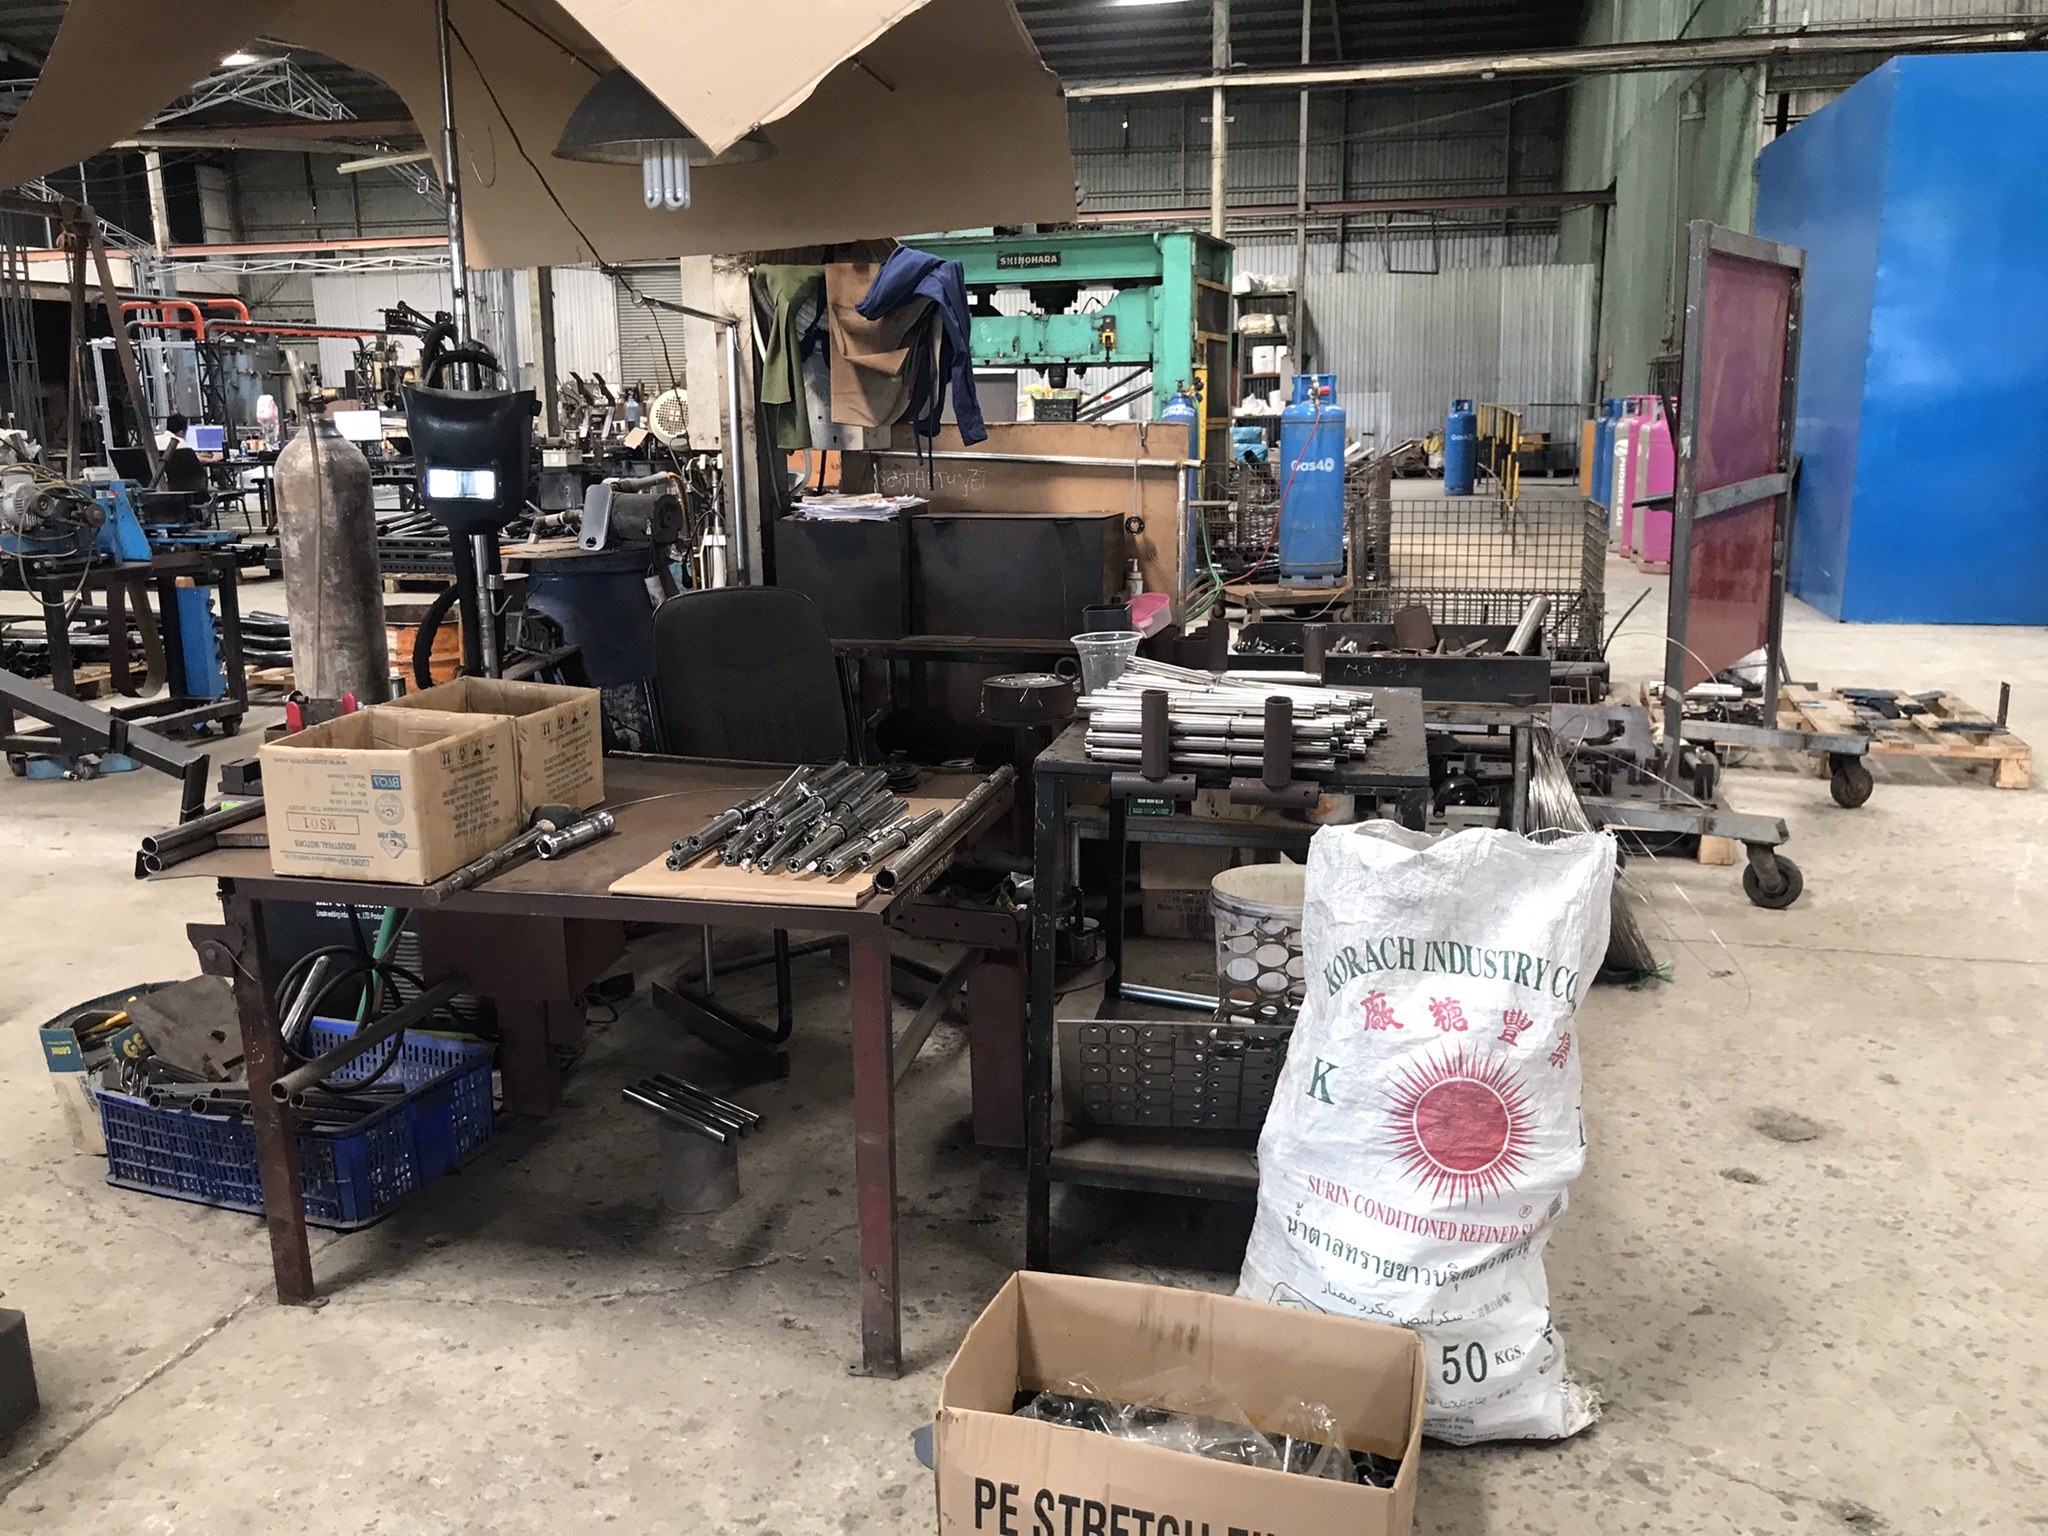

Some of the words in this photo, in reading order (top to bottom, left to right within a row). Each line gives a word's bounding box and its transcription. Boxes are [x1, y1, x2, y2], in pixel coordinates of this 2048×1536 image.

[1000, 255, 1057, 265] SHINOHARA
[1617, 456, 1626, 504] PHOENIX
[1616, 505, 1624, 527] GAS
[1323, 937, 1416, 997] KORACH
[1422, 941, 1551, 991] INDUSTRY
[1306, 1056, 1340, 1105] K
[1307, 1175, 1351, 1205] SURIN
[1354, 1193, 1457, 1241] CONDITIONED
[1460, 1222, 1518, 1244] REFINED
[1441, 1341, 1488, 1385] 50
[1494, 1344, 1526, 1366] KGS.
[974, 1477, 1020, 1536] PE
